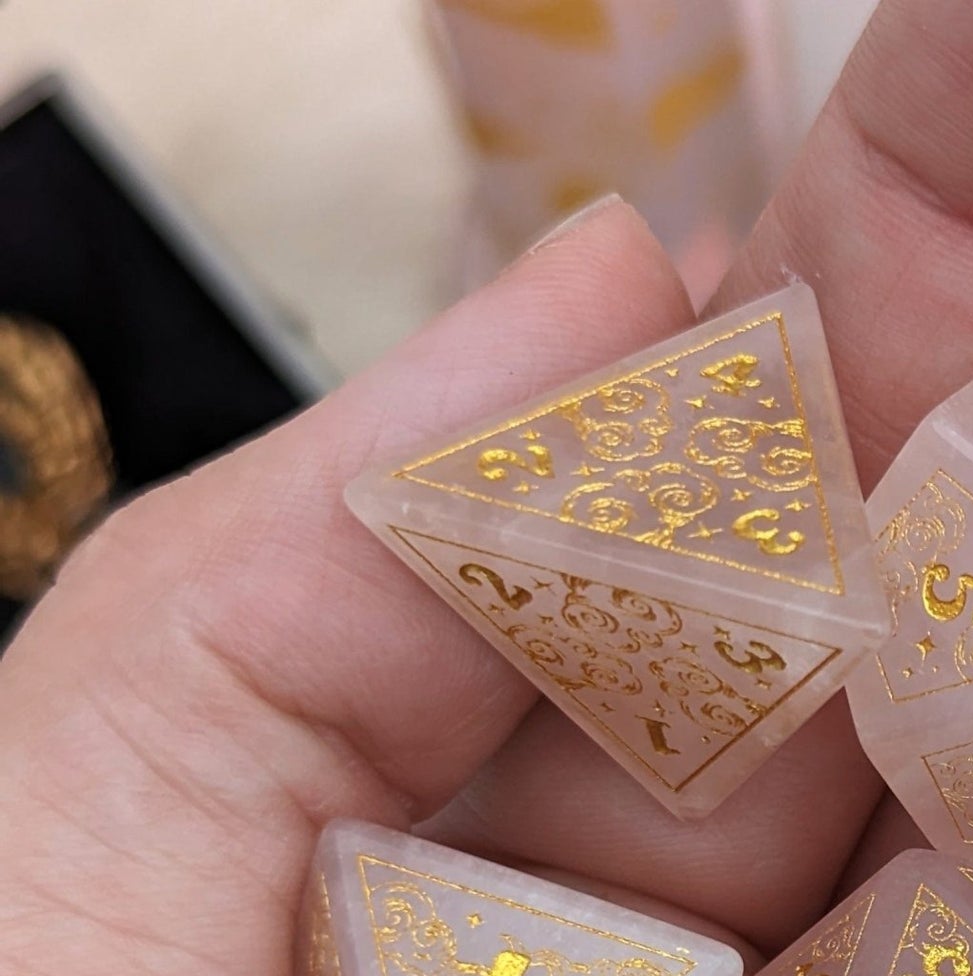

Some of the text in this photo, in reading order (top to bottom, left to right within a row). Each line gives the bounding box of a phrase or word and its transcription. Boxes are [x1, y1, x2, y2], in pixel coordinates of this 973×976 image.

[476, 444, 556, 482] 2
[731, 506, 807, 556] 3
[457, 562, 534, 611] 2
[713, 639, 788, 675] 3
[633, 713, 682, 757] 1
